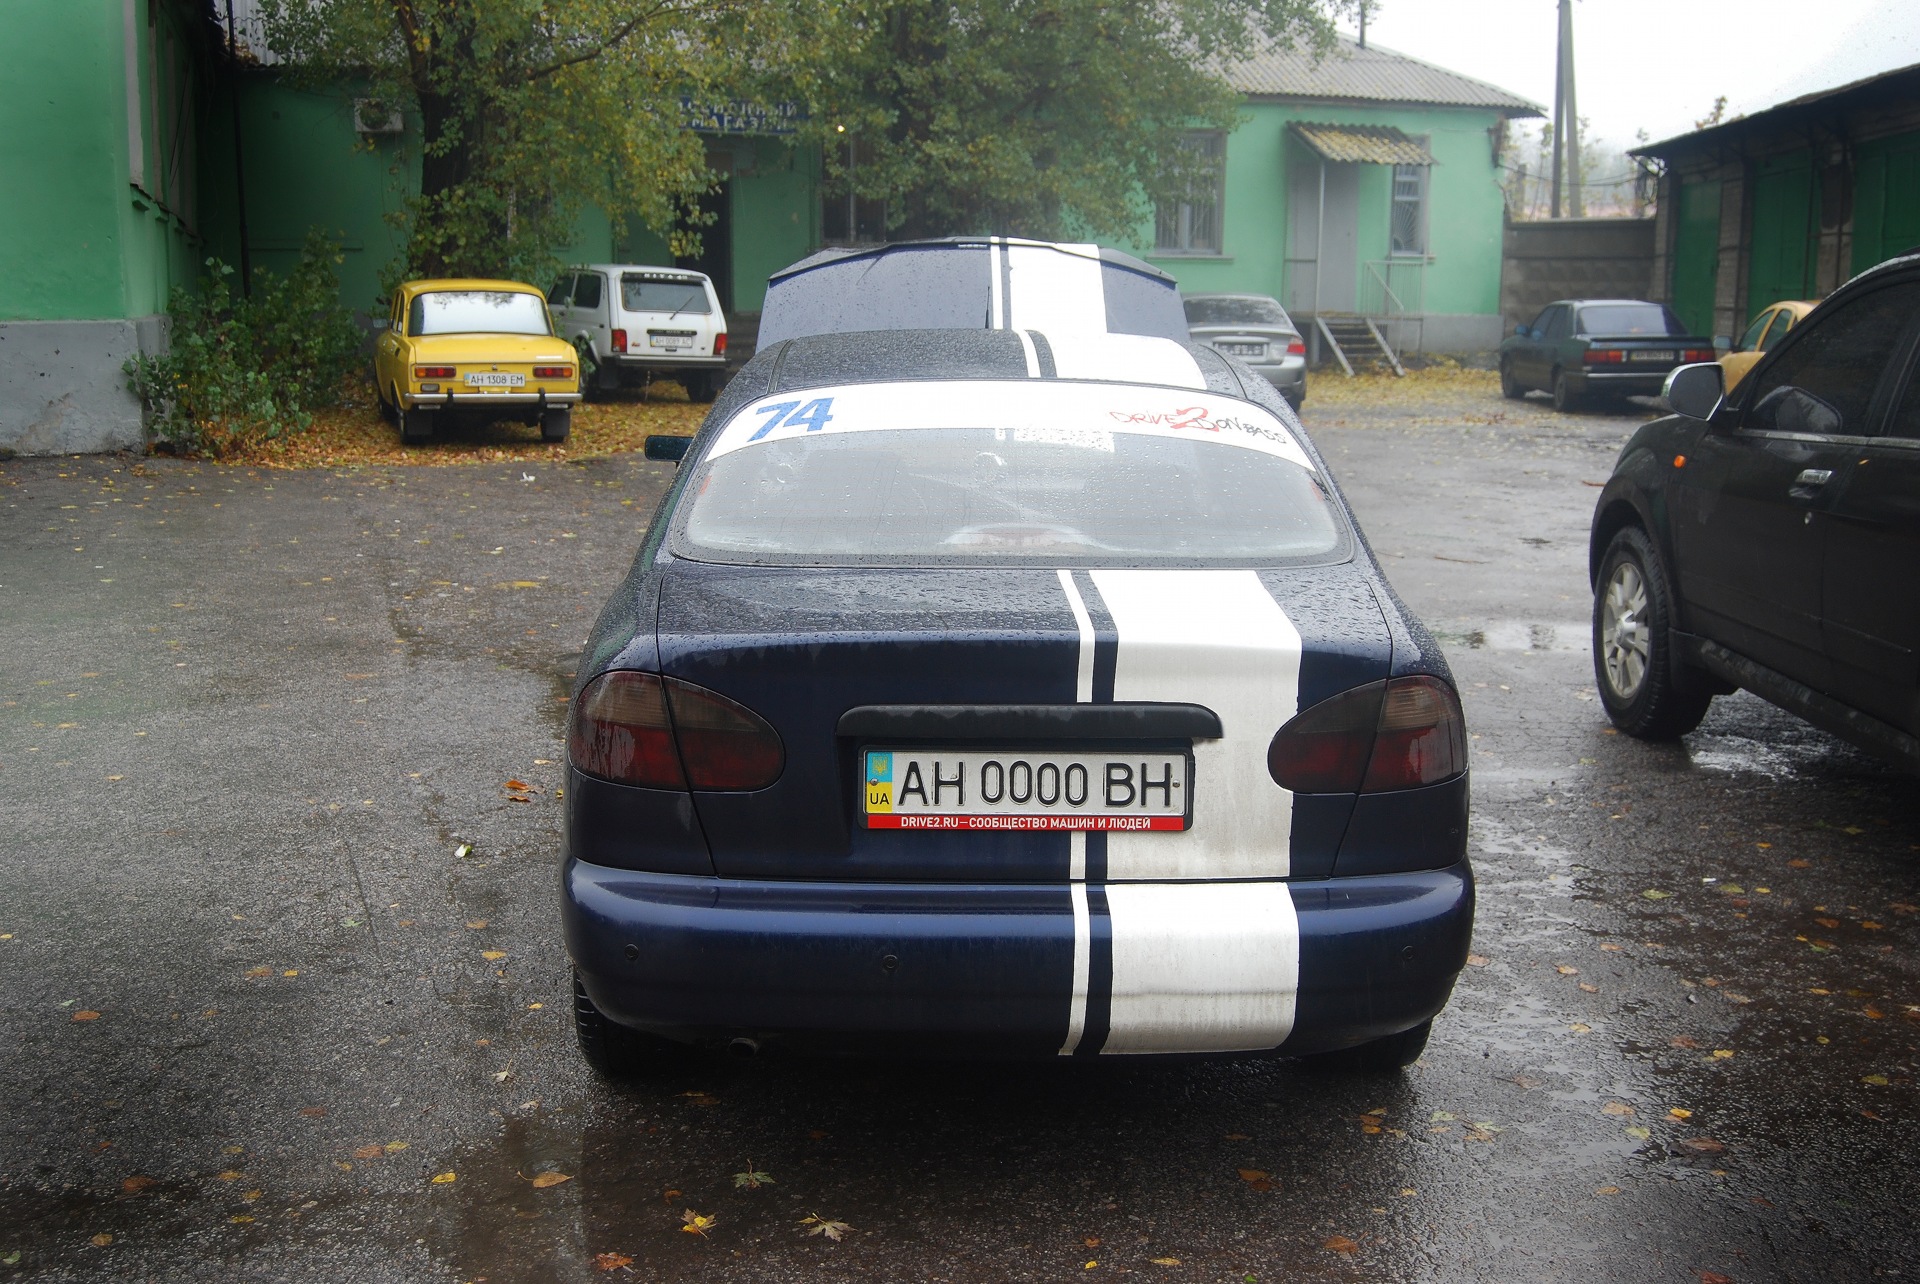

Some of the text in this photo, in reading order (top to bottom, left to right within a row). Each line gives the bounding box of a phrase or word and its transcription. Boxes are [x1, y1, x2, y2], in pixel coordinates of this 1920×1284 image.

[470, 375, 523, 384] AH 1308 EM
[747, 397, 835, 442] 74
[898, 760, 1172, 807] AH 0000 BH
[869, 792, 890, 805] UA
[1050, 817, 1095, 829] МАШИН
[1097, 818, 1106, 829] И
[1108, 816, 1151, 831] ЛЮДЕЙ
